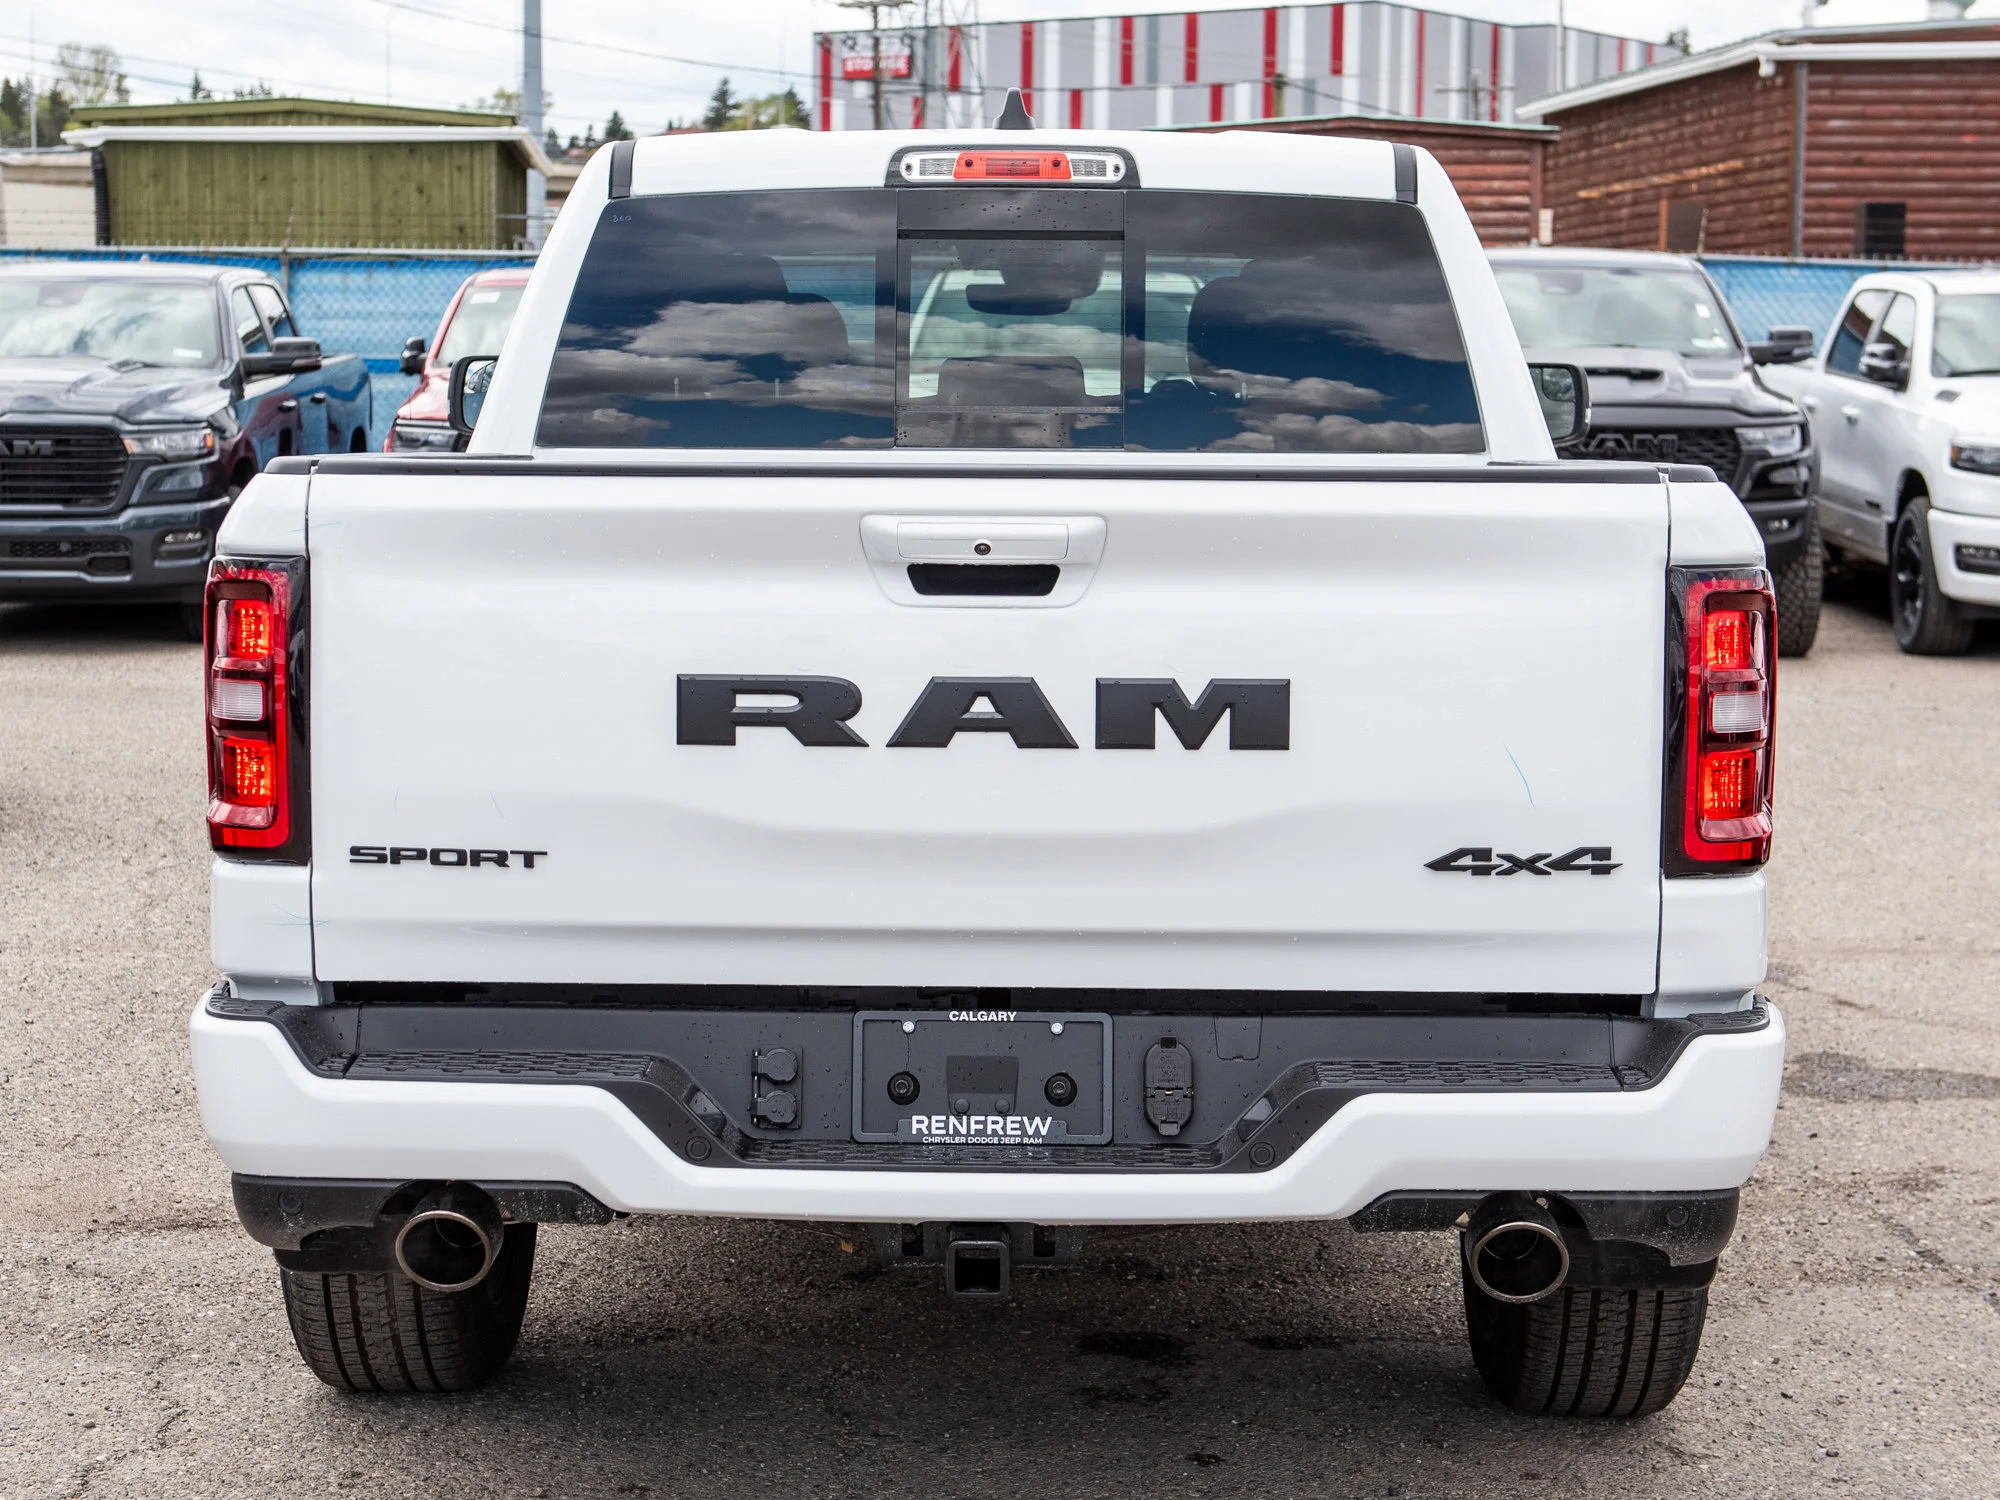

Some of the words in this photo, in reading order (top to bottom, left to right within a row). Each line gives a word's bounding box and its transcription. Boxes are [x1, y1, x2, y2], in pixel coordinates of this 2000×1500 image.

[844, 56, 909, 73] STOAGE
[1577, 433, 1679, 453] AM
[676, 674, 1291, 751] RAM
[349, 845, 548, 869] SPORT
[1423, 846, 1624, 876] 4x4
[948, 1010, 1017, 1022] CALGARY
[911, 1115, 1052, 1136] RENFREW
[922, 1136, 967, 1144] CHRYSLER
[967, 1136, 999, 1144] DODGE
[1000, 1136, 1022, 1144] JEEP
[1023, 1136, 1043, 1145] RAM
